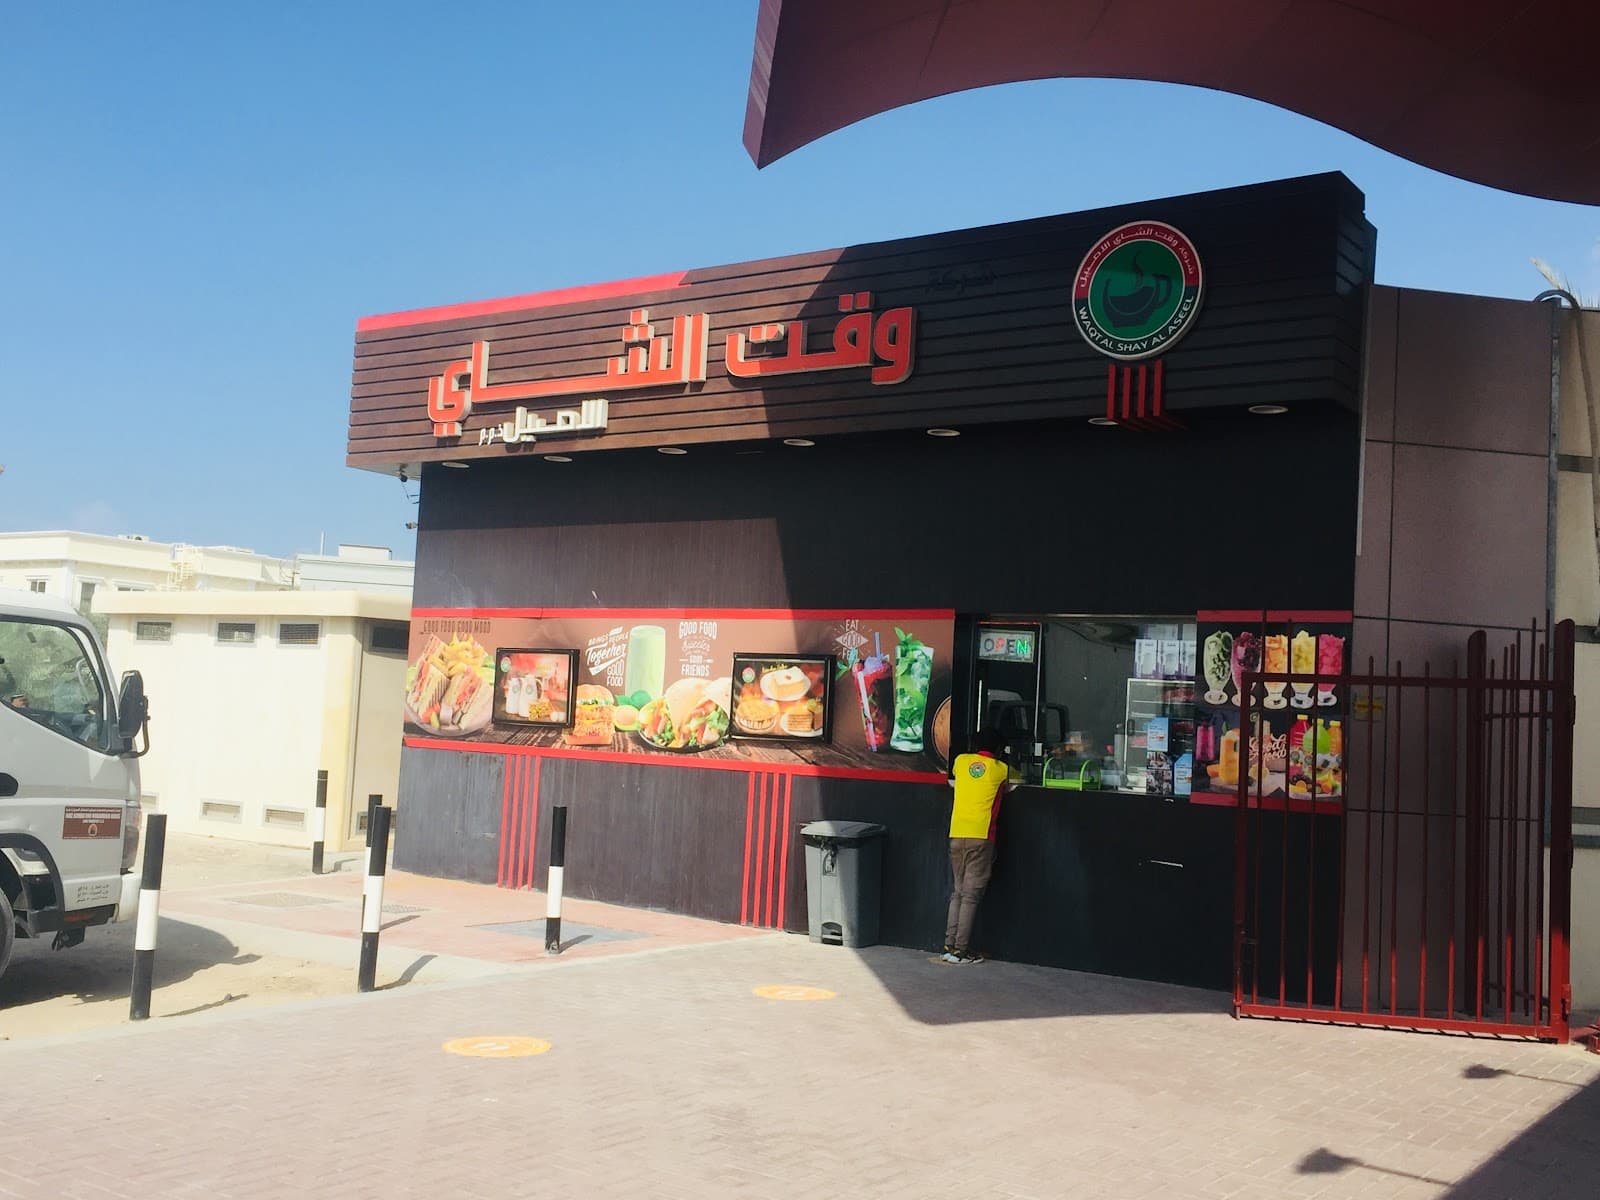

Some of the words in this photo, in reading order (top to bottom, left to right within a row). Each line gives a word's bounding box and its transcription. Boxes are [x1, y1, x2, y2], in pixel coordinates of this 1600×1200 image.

[1078, 306, 1103, 341] WAQT
[1100, 340, 1115, 350] AL
[1116, 341, 1148, 352] SHAY
[1151, 334, 1167, 346] AL
[1168, 295, 1194, 335] ASEEL
[726, 291, 917, 385] وقت
[679, 621, 698, 639] GOOD
[699, 621, 718, 640] FOOD
[845, 619, 860, 632] EAT
[841, 632, 862, 649] GOOD
[984, 637, 1029, 656] OPEN
[585, 642, 627, 666] Together
[607, 659, 625, 676] GOOD
[681, 664, 711, 677] FRIENDS
[607, 676, 624, 687] FOOD
